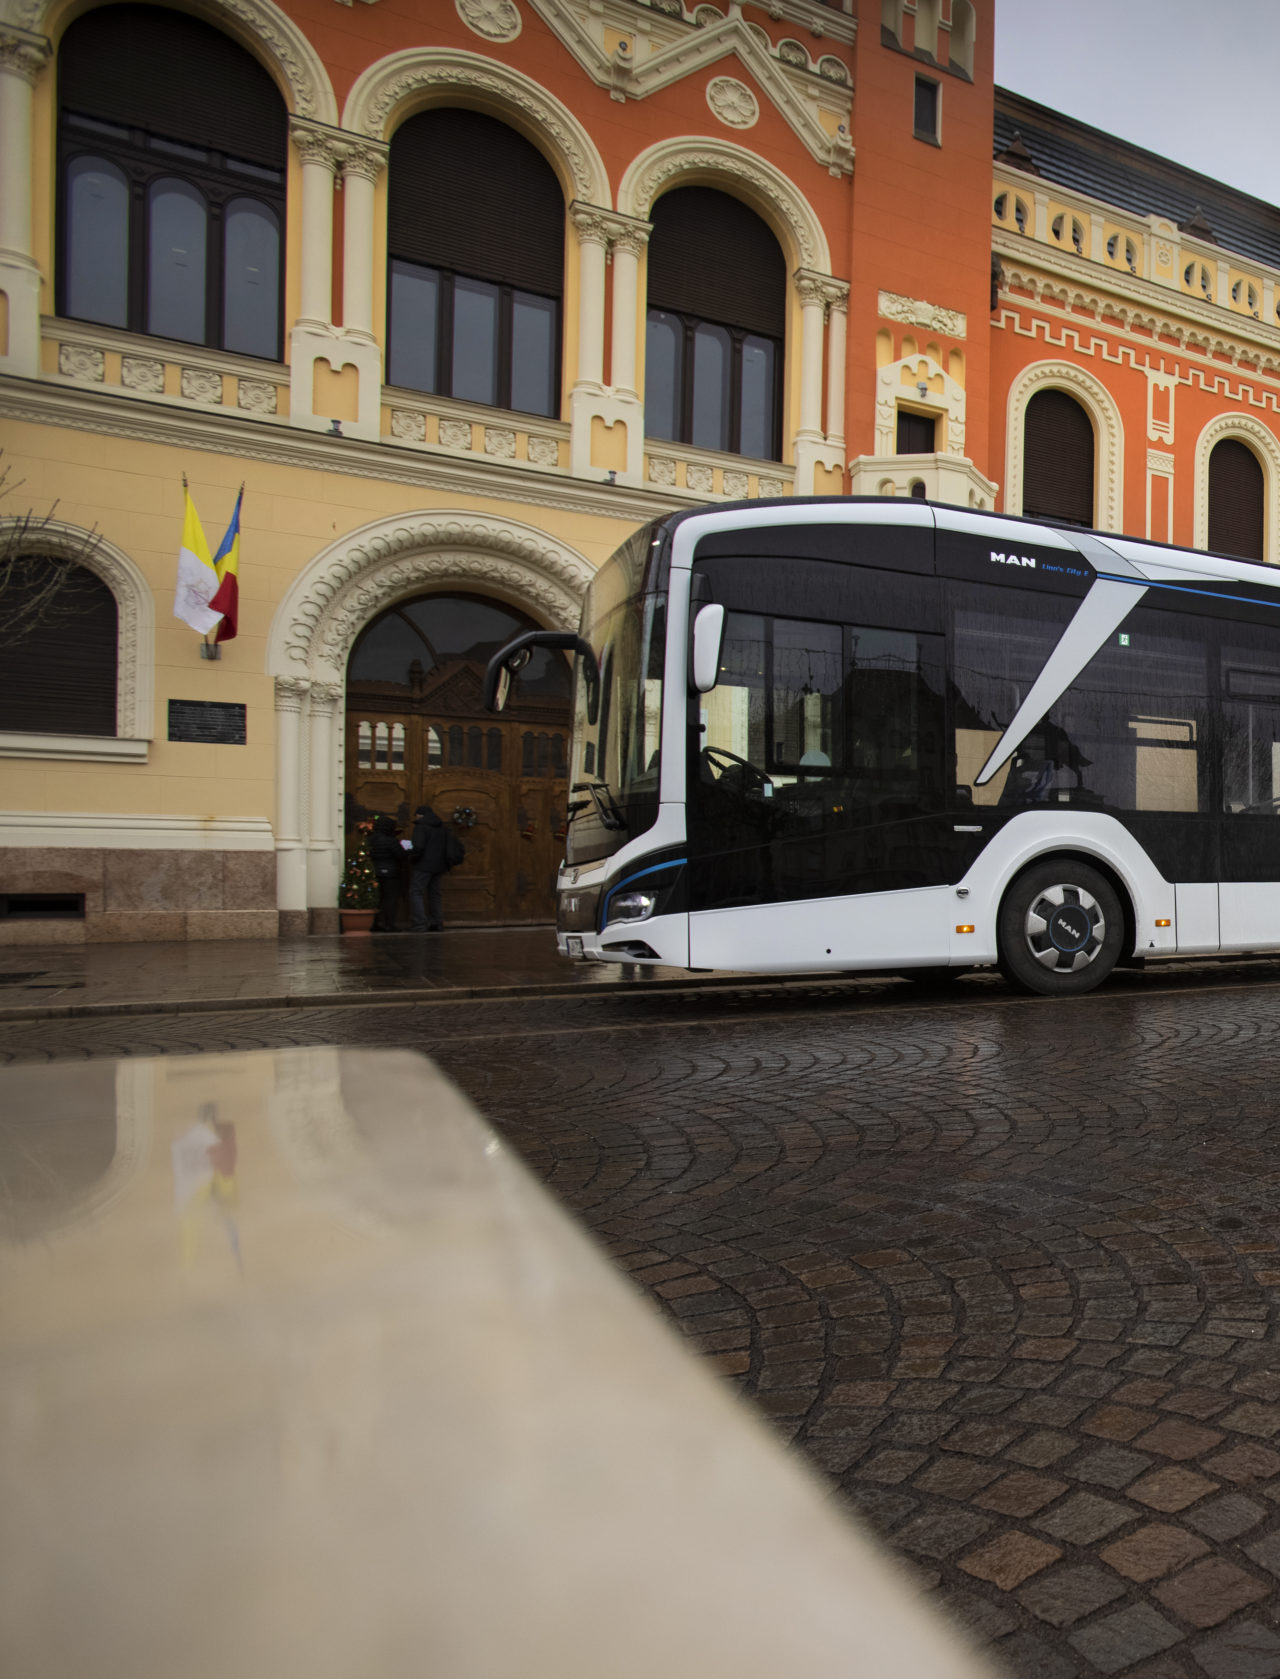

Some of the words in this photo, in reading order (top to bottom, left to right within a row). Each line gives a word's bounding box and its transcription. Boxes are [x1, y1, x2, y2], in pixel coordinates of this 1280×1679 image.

[990, 552, 1036, 568] MAN
[1066, 567, 1082, 576] City
[1058, 919, 1080, 938] MAN
